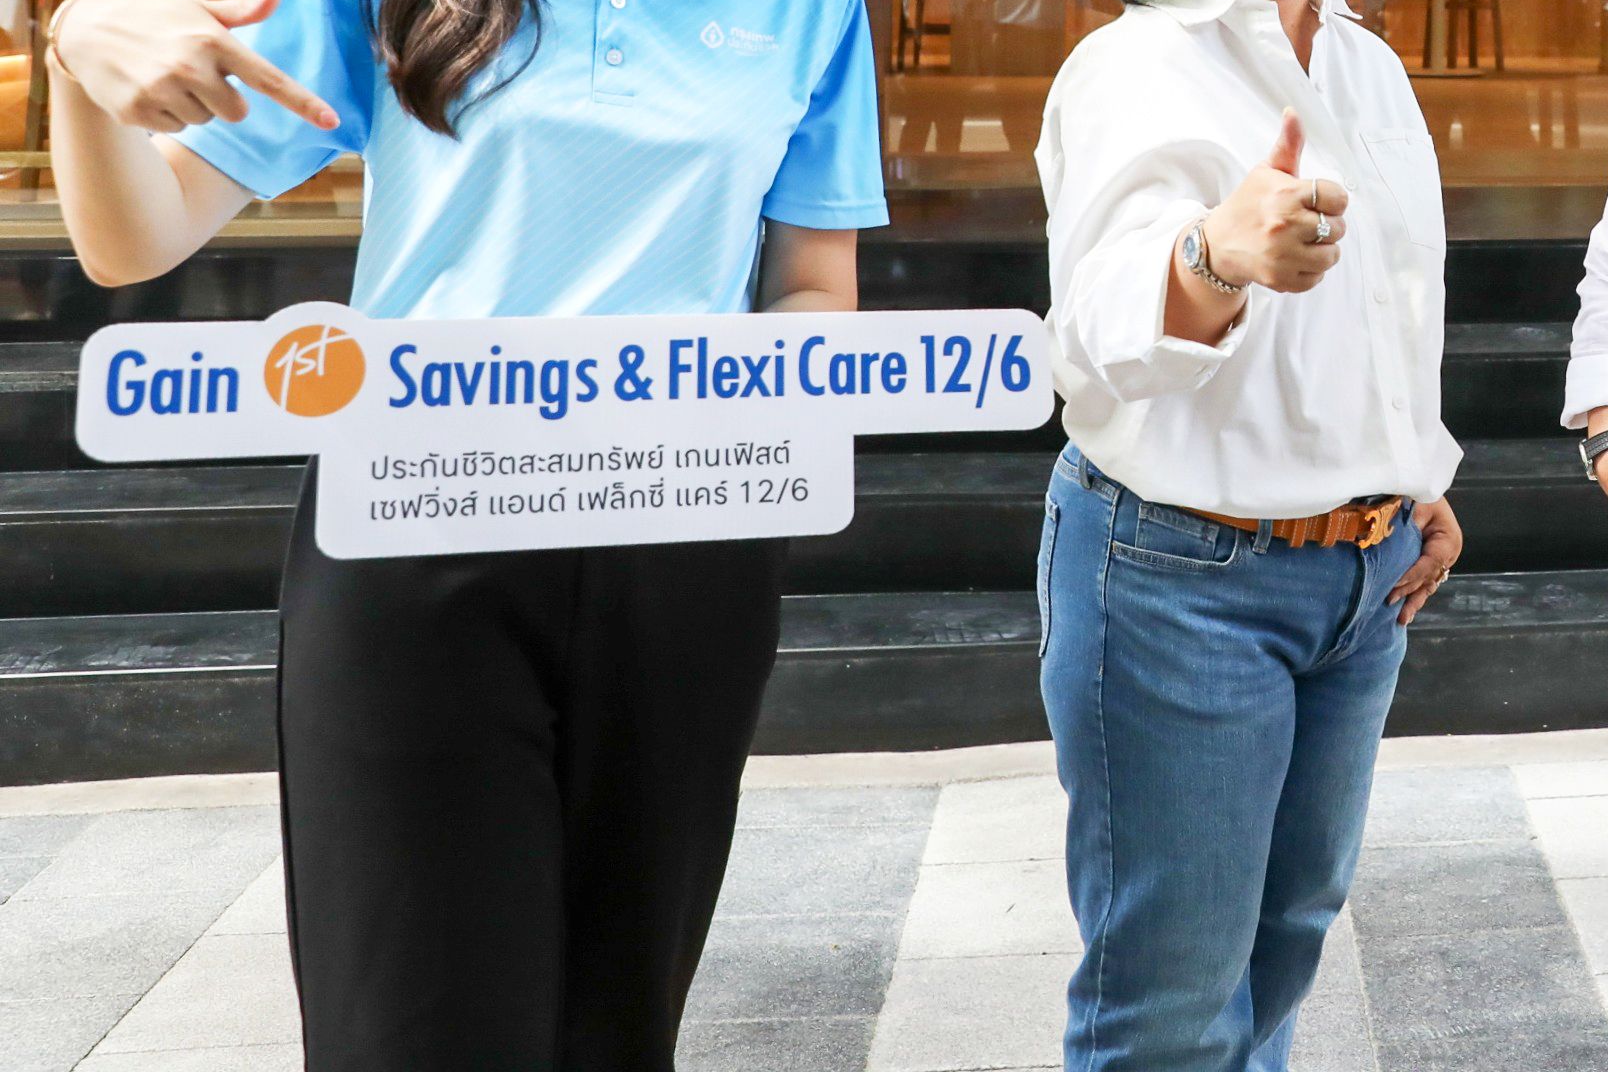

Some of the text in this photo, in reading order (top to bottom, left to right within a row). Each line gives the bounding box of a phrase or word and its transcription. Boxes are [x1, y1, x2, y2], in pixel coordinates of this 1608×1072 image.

[107, 326, 1030, 419] Gain 1st Savings & Flexi Care 12/6
[371, 440, 790, 480] ประกันชีวิตสะสมทรัพย์ เกนเฟิสต์
[370, 478, 808, 520] เซฟวิ่งส์ แอนด์ เฟล็กซี่ แคร์ 12/6
